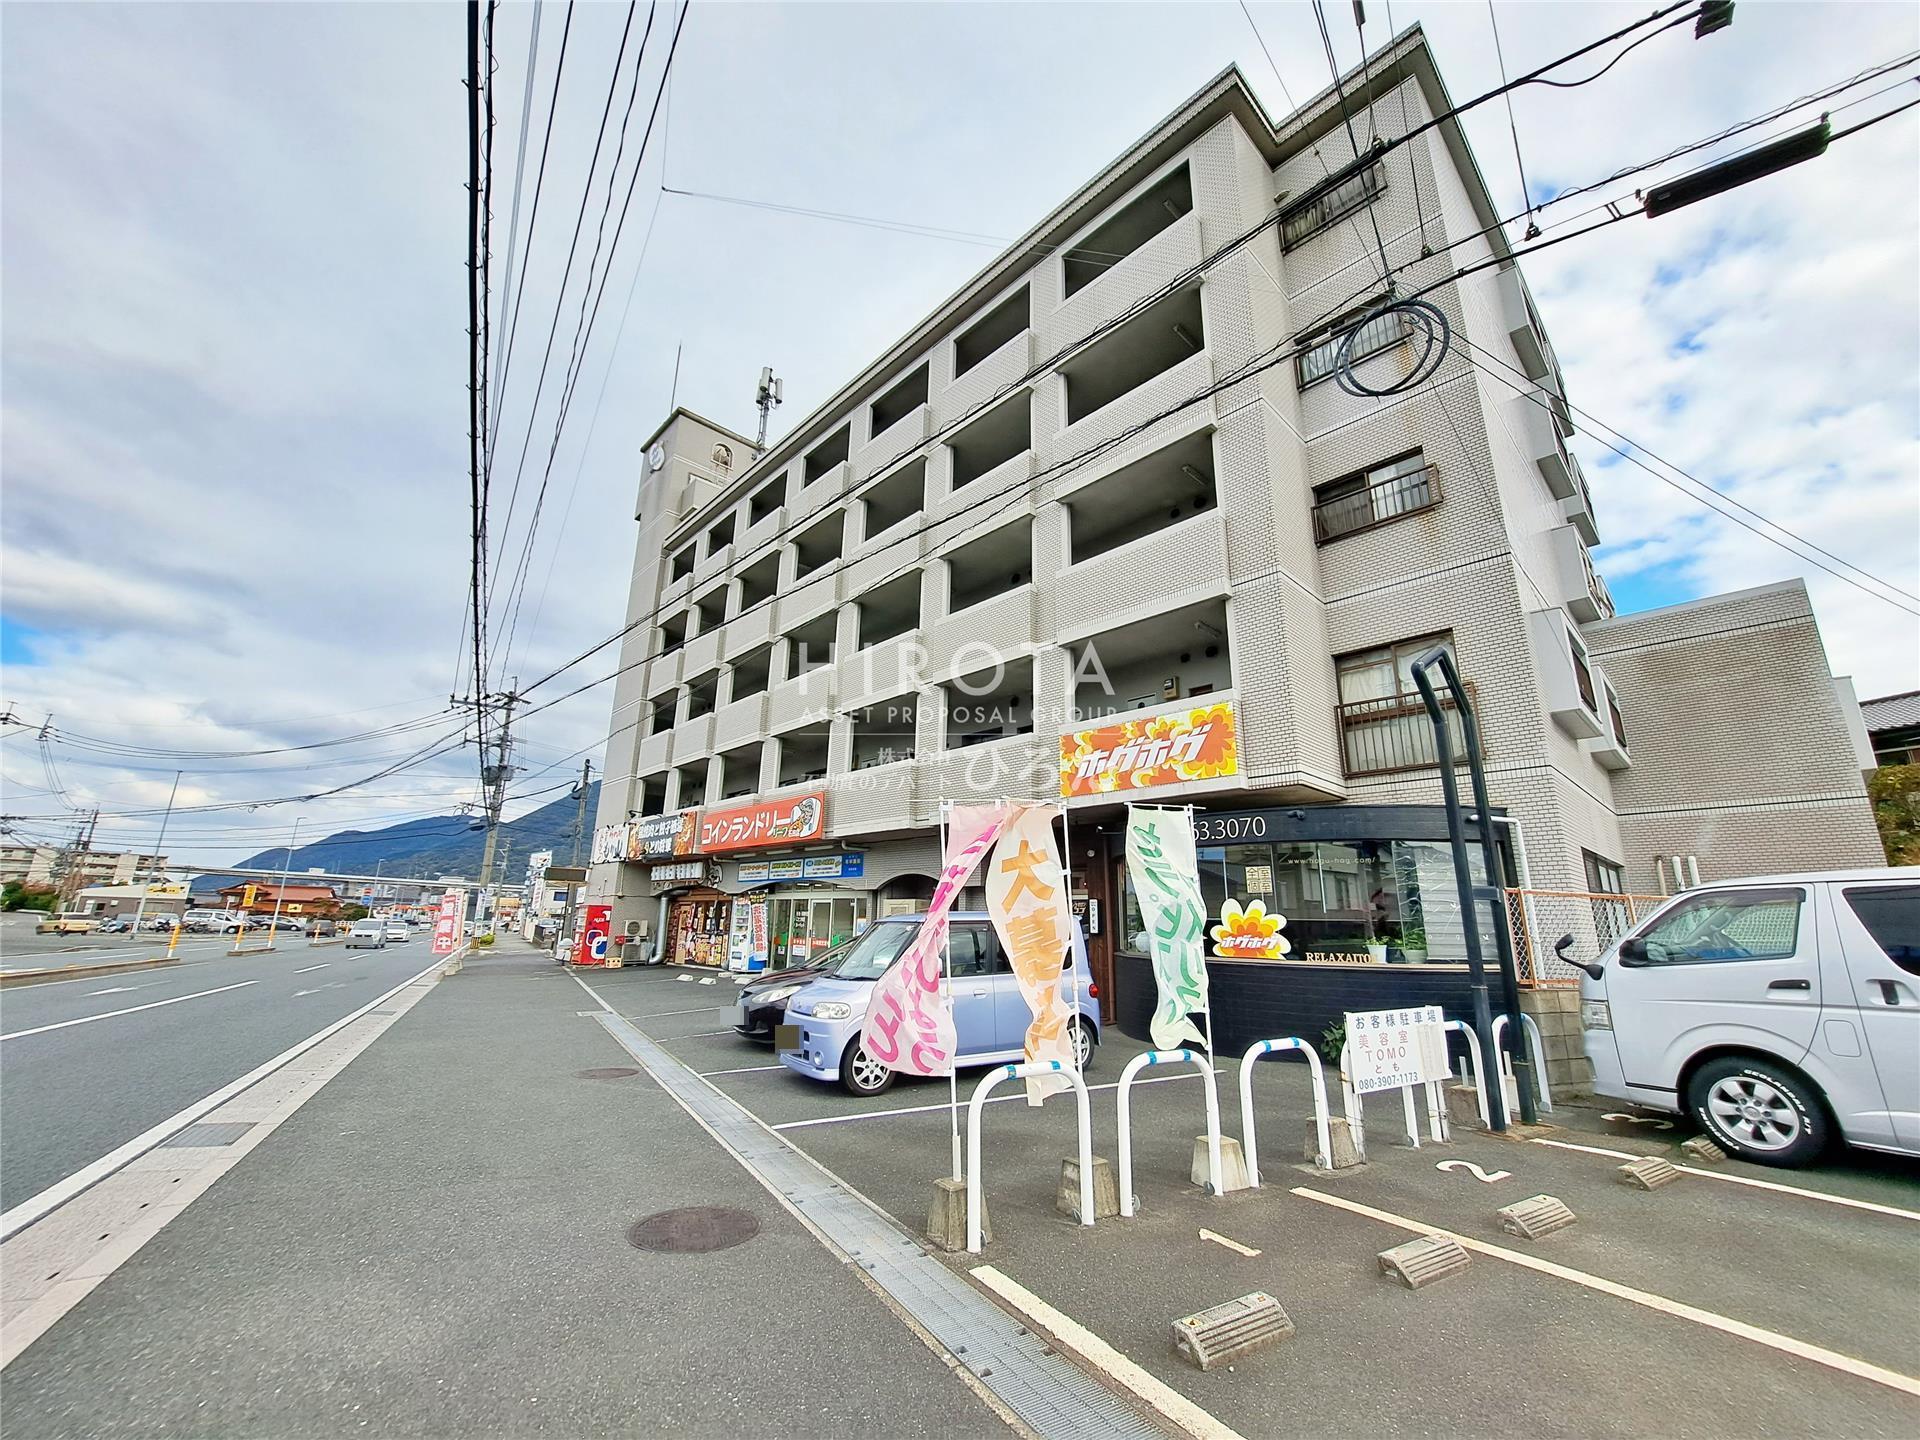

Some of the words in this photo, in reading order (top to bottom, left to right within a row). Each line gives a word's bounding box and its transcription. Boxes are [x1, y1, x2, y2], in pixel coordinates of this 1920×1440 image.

[1076, 723, 1213, 778] ホグホグ
[701, 810, 793, 845] コインランドリー
[1221, 935, 1279, 950] ホグホグ
[1355, 1009, 1437, 1030] お客様駐車場
[1359, 1030, 1408, 1049] 美容室
[1365, 1046, 1406, 1062] TOMO
[1375, 1062, 1400, 1074] とも
[1359, 1071, 1418, 1090] 080-3907-1173
[1435, 1159, 1512, 1183] 2
